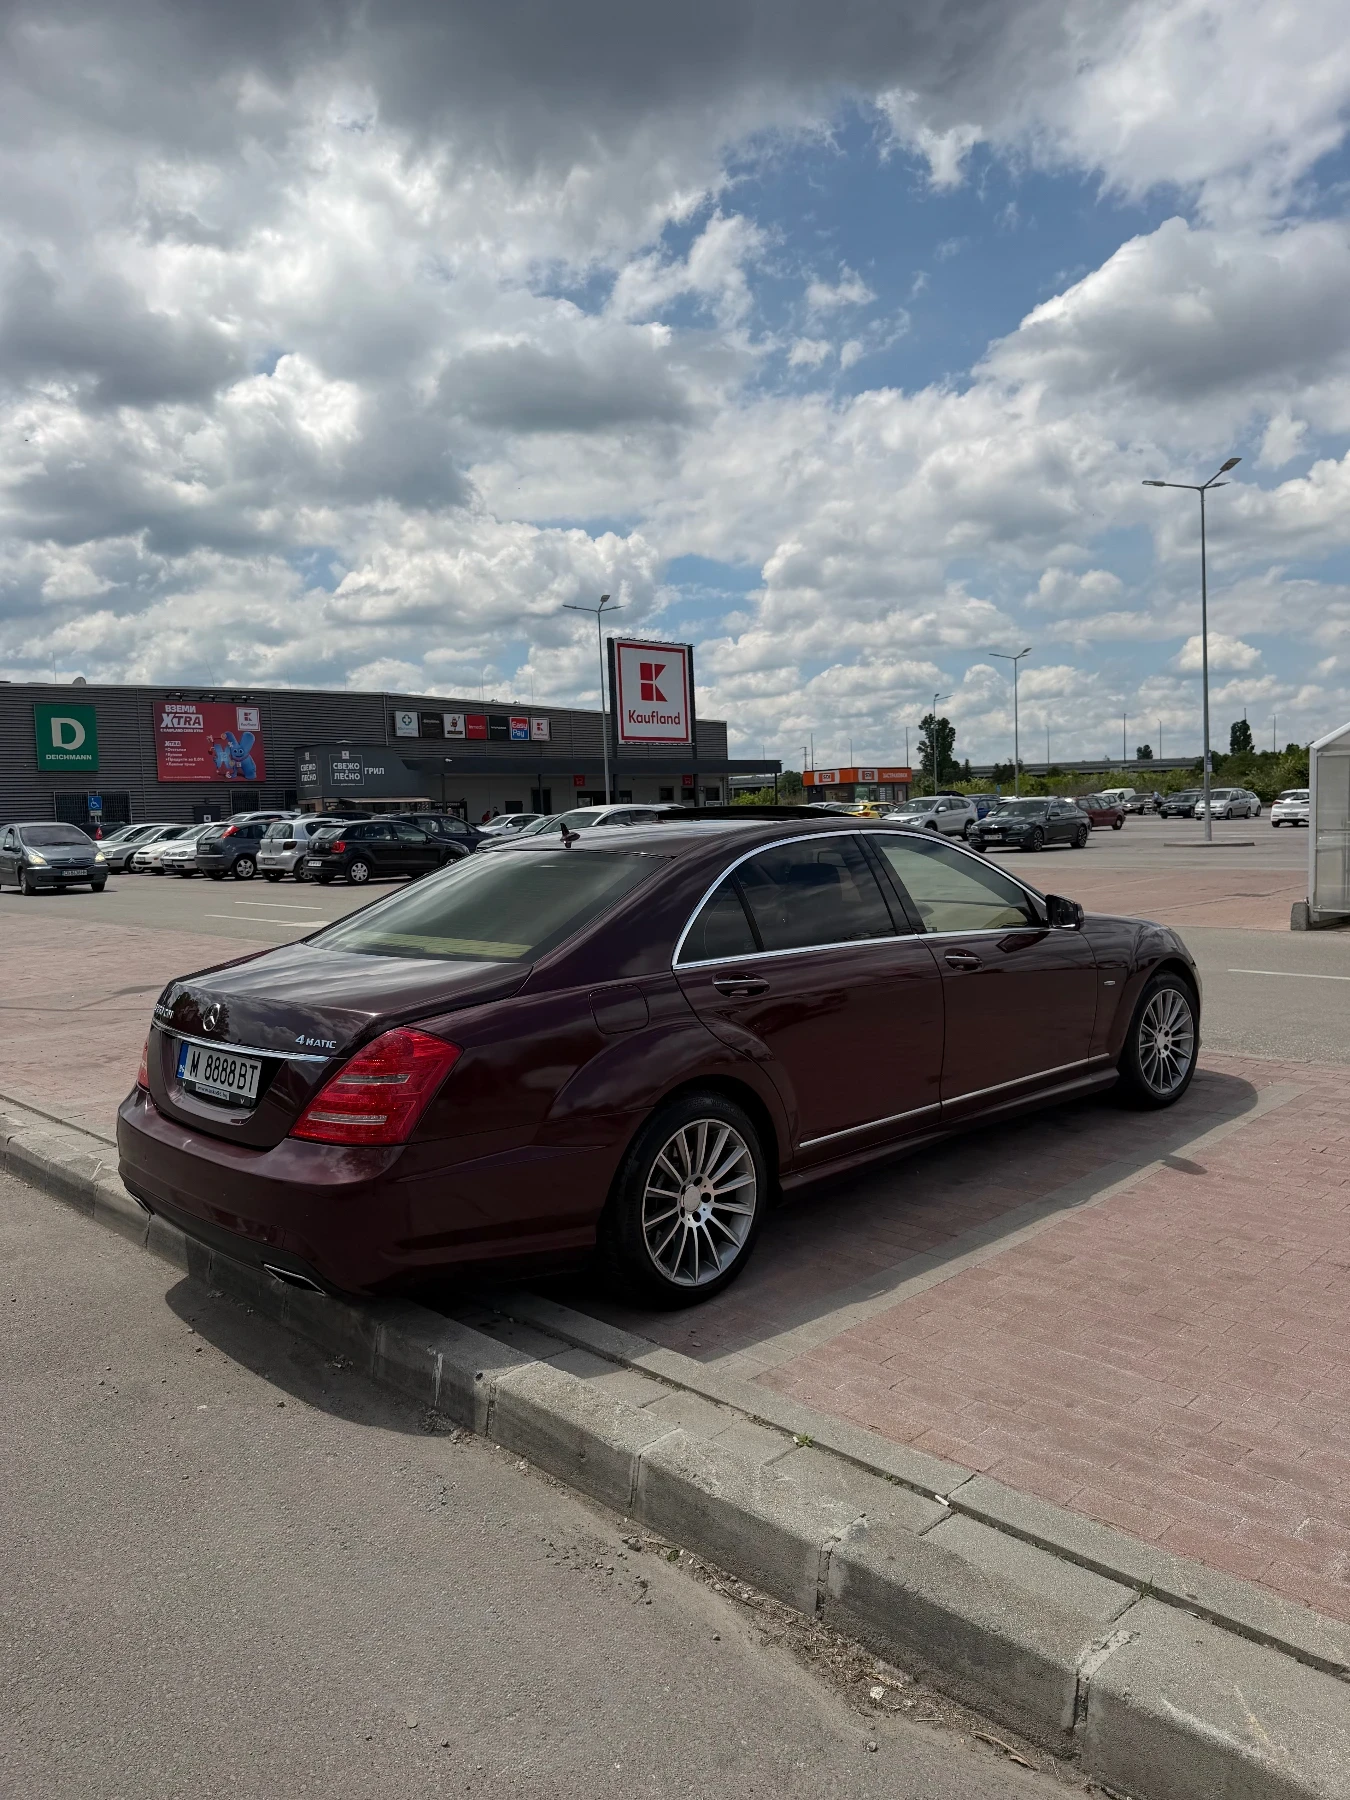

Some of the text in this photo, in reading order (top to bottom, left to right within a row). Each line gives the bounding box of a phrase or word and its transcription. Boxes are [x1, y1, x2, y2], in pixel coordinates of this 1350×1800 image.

[164, 704, 197, 714] ВЗЕМИ
[160, 713, 204, 729] XTRA
[628, 709, 681, 725] Kaufland
[511, 721, 528, 731] Easy
[50, 717, 86, 751] D
[512, 729, 525, 738] Pay
[332, 762, 360, 770] СВЕЖО
[364, 767, 385, 775] ГРИЛ
[334, 772, 361, 780] ЛЕСНО
[189, 1050, 201, 1078] M
